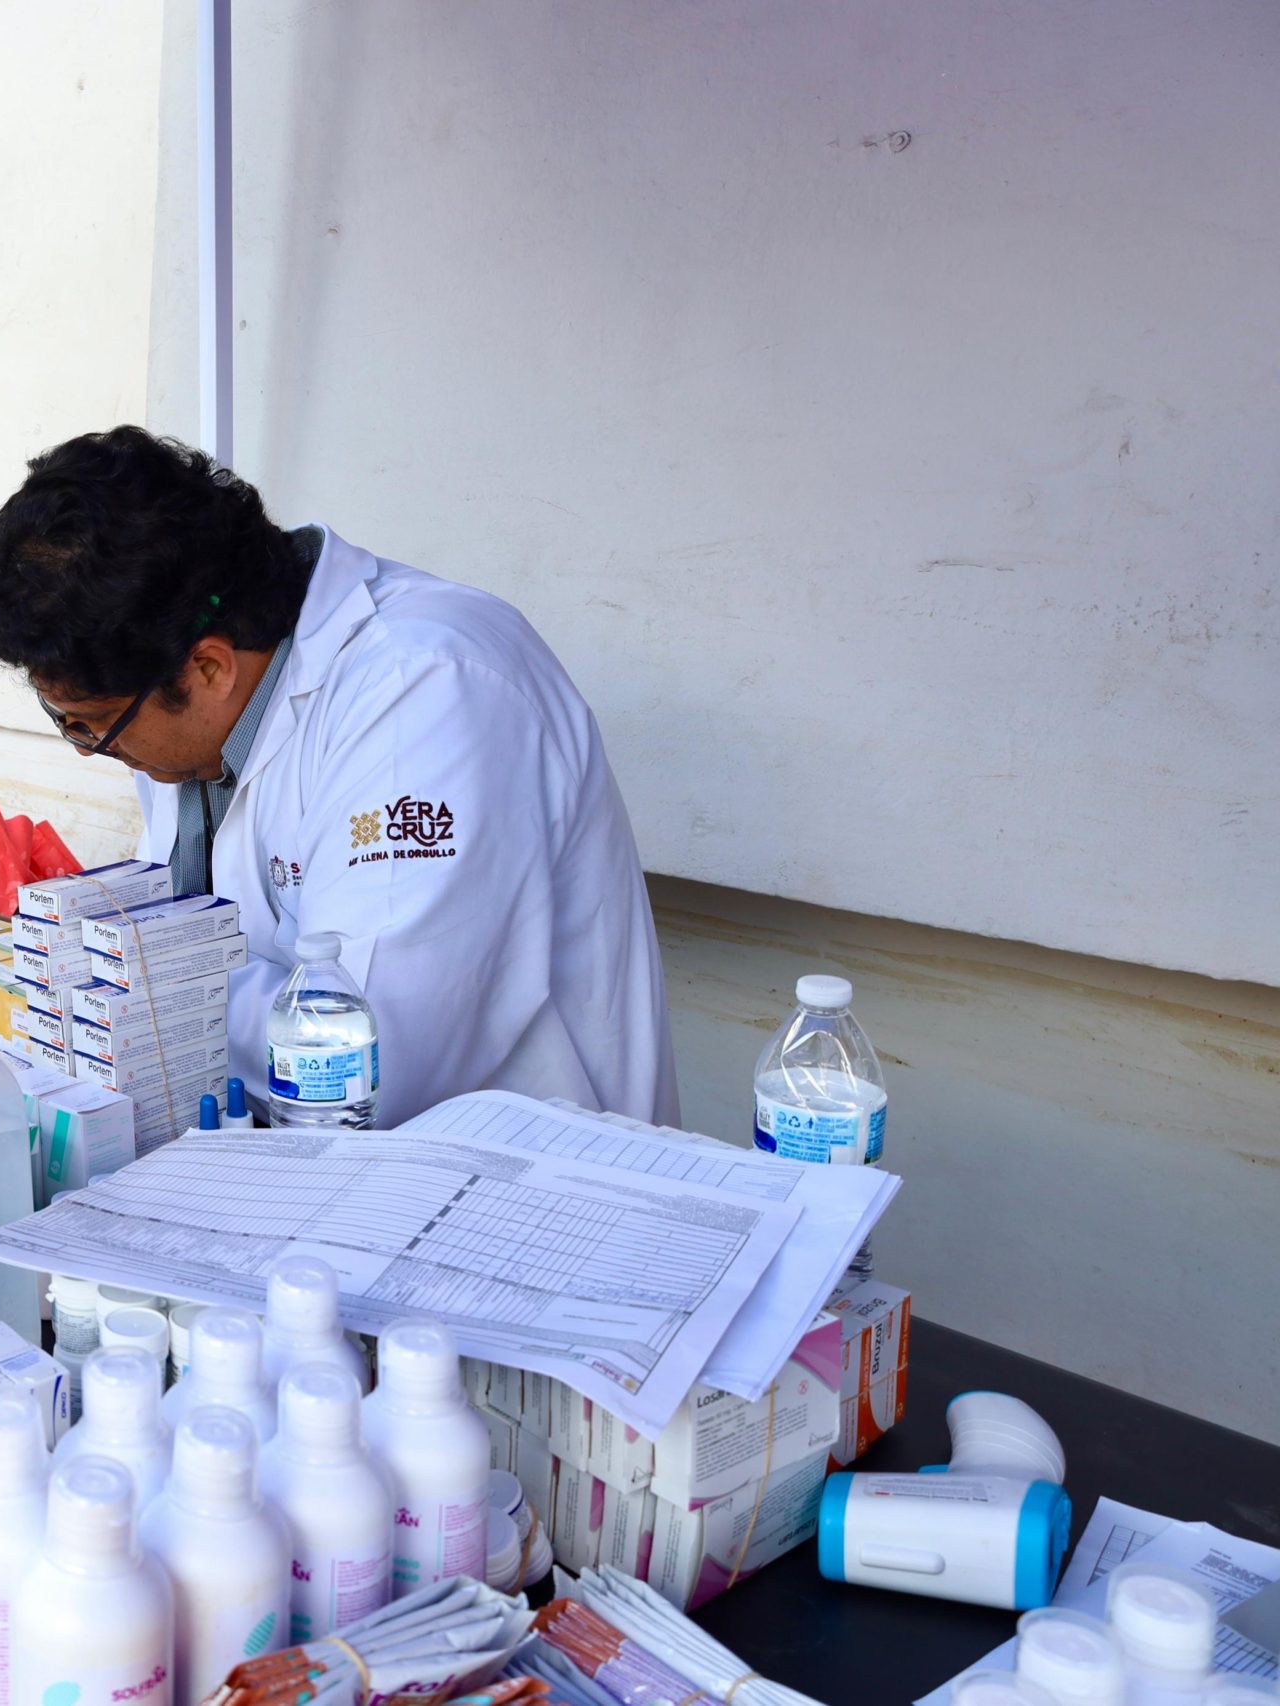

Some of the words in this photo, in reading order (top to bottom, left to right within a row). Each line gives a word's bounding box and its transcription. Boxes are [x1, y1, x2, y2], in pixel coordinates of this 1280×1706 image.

[385, 795, 453, 821] VERA
[386, 821, 453, 846] CRUZ
[361, 850, 389, 863] LLENA
[393, 849, 406, 859] DE
[407, 847, 456, 859] ORGULLO
[29, 891, 54, 905] Portem
[21, 922, 44, 936] Portem
[94, 925, 118, 940] Portem
[23, 954, 44, 968] Portem
[84, 994, 107, 1010] Portem
[38, 1016, 60, 1031] Portem
[85, 1029, 109, 1045] Portem
[42, 1047, 66, 1064] Portem
[88, 1061, 113, 1077] Portem
[857, 1297, 888, 1317] Bruzol
[871, 1323, 883, 1375] Bruzol
